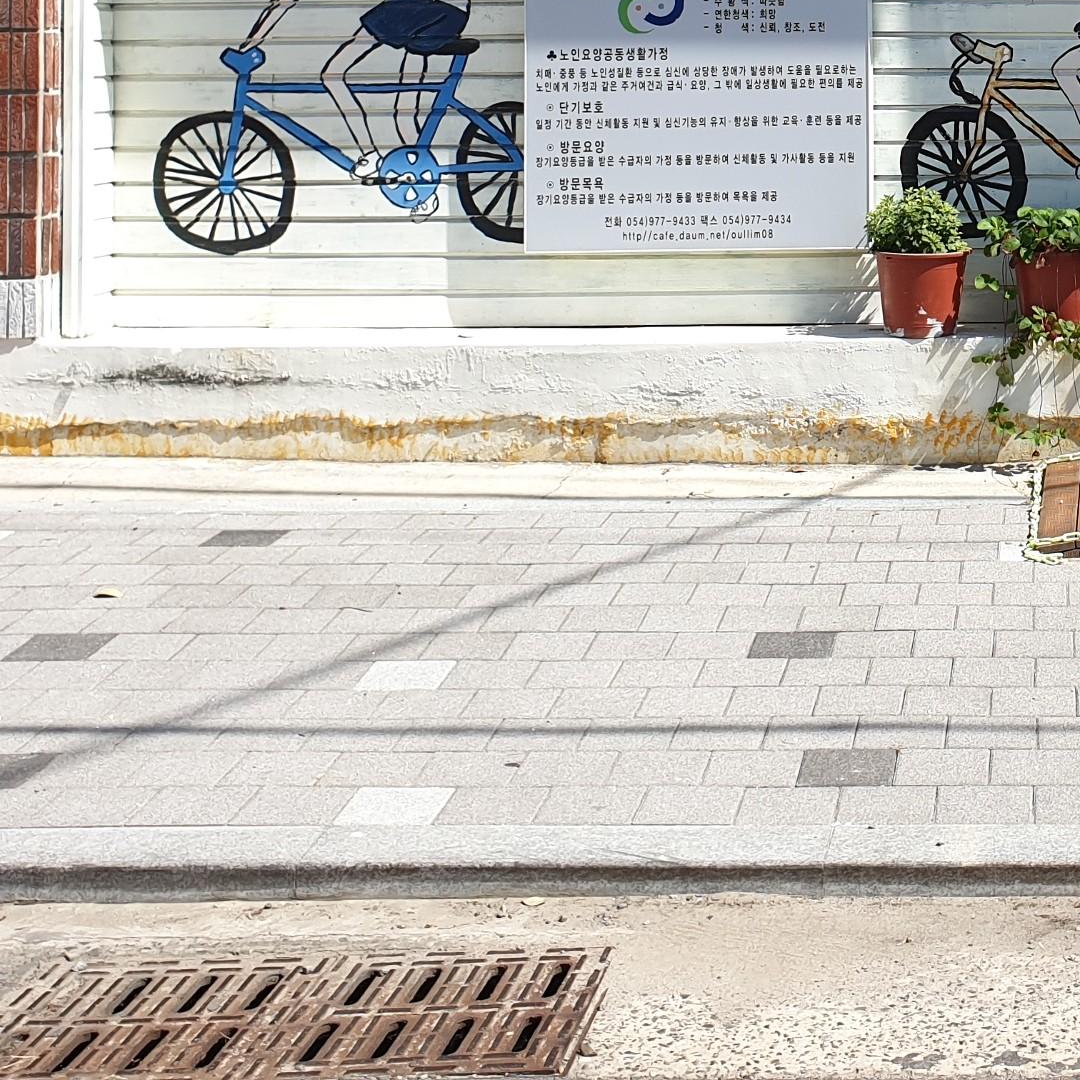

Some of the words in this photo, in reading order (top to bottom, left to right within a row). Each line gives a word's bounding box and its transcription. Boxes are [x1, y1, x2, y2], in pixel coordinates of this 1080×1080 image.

[760, 9, 776, 20] 희망
[759, 22, 780, 33] 신뢰,
[784, 22, 805, 33] 창조,
[808, 22, 826, 33] 도전
[560, 48, 667, 61] 노인요양공동생활가정
[579, 68, 587, 79] 등
[591, 67, 632, 78] 노인성질환
[636, 67, 661, 78] 등으로
[665, 67, 689, 77] 심신에
[694, 66, 717, 77] 상당한
[722, 66, 746, 77] 장애가
[751, 65, 783, 76] 발생하여
[787, 65, 811, 75] 도움을
[816, 64, 856, 75] 필요로하는
[536, 82, 568, 92] 노인에게
[573, 81, 597, 92] 가정과
[602, 81, 617, 92] 같은
[621, 80, 663, 91] 주거여건과
[714, 81, 721, 89] 그
[726, 79, 741, 90] 밖에
[746, 78, 786, 89] 일상생활에
[791, 78, 815, 89] 필요한
[819, 78, 842, 88] 편의를
[848, 78, 863, 88] 제공
[560, 101, 603, 114] 단기보호
[536, 119, 551, 130] 일정
[556, 119, 571, 130] 기간
[576, 119, 591, 129] 동안
[596, 118, 629, 129] 신체활동
[633, 118, 649, 128] 지원
[653, 118, 661, 128] 및
[665, 117, 707, 128] 심신기능의
[763, 115, 778, 126] 위한
[826, 115, 842, 126] 등을
[846, 115, 862, 125] 제공
[560, 140, 604, 154] 방문요양
[536, 156, 594, 168] 장기요양등급을
[599, 155, 614, 166] 받은
[618, 155, 651, 166] 수급자의
[656, 155, 671, 166] 가정
[676, 155, 692, 166] 등을
[696, 154, 728, 165] 방문하여
[733, 153, 766, 164] 신체활동
[771, 153, 777, 164] 및
[782, 153, 814, 164] 가사활동
[819, 152, 834, 163] 등을
[839, 152, 854, 163] 지원
[560, 177, 604, 191] 방문목욕
[536, 194, 594, 205] 장기요양등급을
[599, 193, 615, 204] 받은
[619, 193, 651, 204] 수급자의
[656, 193, 672, 203] 가정
[676, 192, 692, 203] 등을
[696, 192, 729, 203] 방문하여
[733, 191, 757, 202] 목욕을
[762, 191, 777, 202] 제공
[605, 216, 622, 228] 전화
